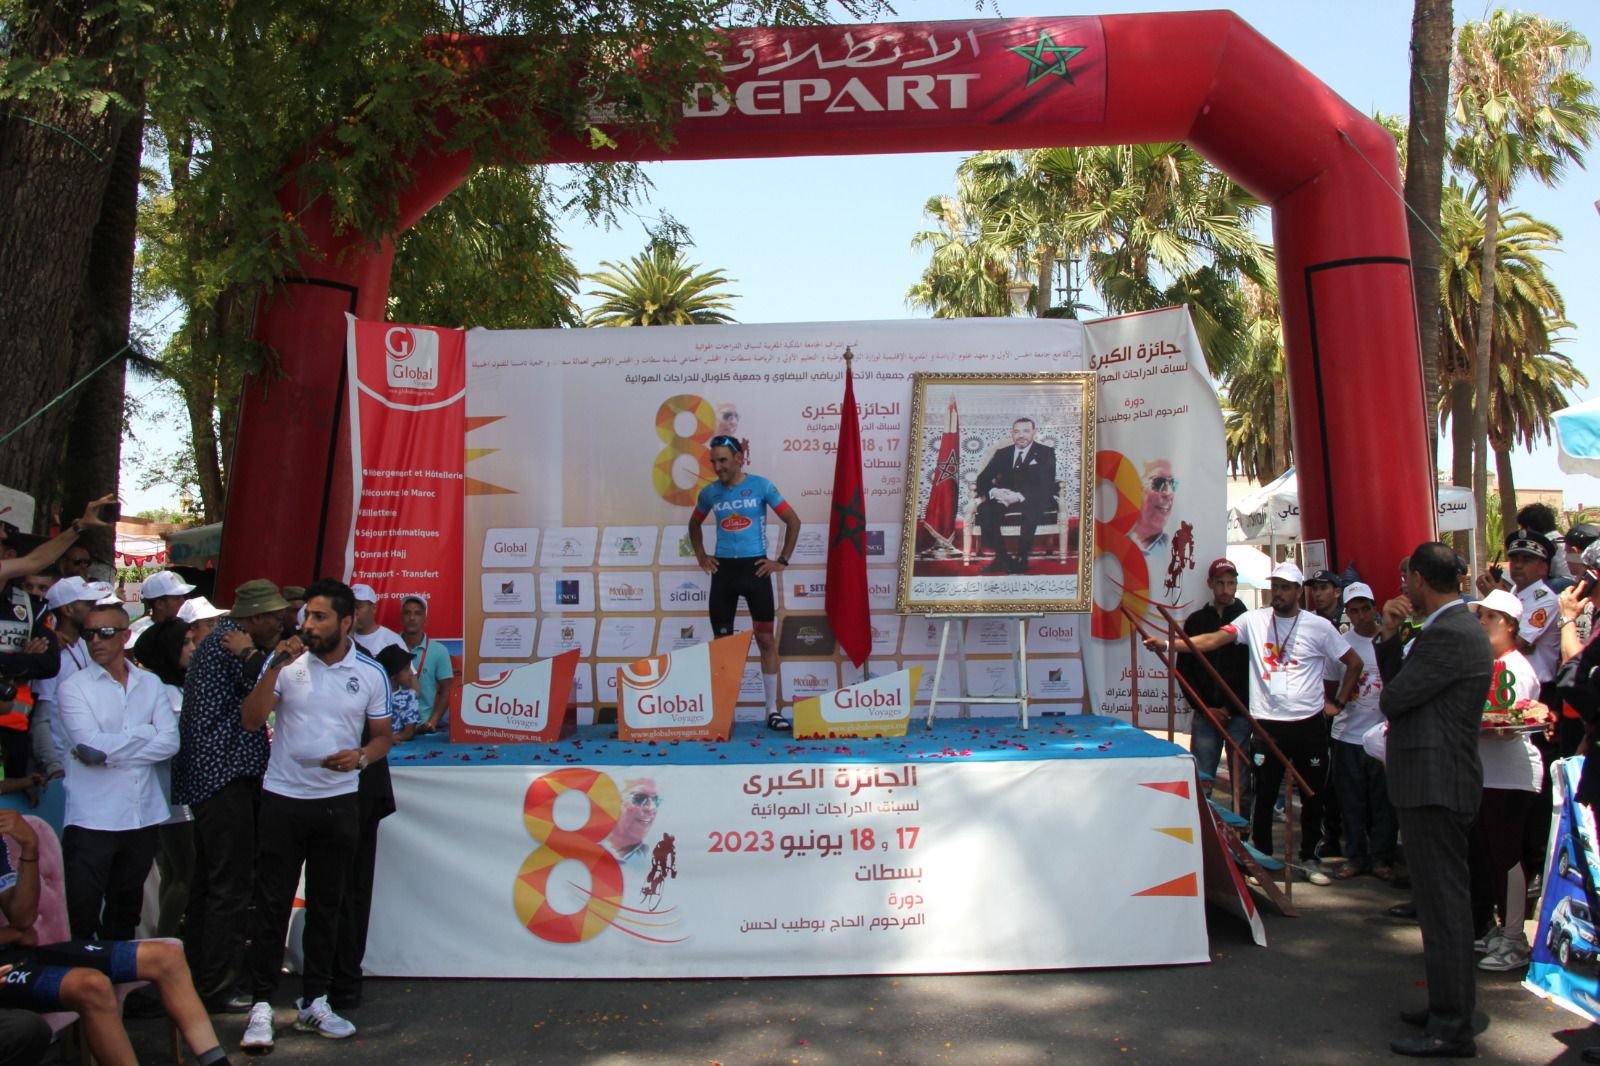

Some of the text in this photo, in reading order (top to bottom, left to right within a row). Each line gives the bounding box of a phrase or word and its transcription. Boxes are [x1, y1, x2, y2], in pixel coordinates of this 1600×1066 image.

[1089, 345, 1132, 370] الكبرى
[393, 364, 433, 380] Global
[1122, 366, 1158, 380] الدراجات
[1160, 361, 1188, 376] لسباق
[625, 373, 661, 384] الهوائية
[663, 372, 699, 384] للدراجات
[732, 372, 762, 382] جمعية
[1124, 397, 1145, 409] دورة
[1132, 409, 1153, 422] الحاج
[1154, 405, 1188, 419] المرحوم
[783, 439, 820, 452] 2023
[887, 439, 900, 451] 17
[425, 470, 464, 480] Hôtellerie
[410, 489, 436, 497] Maroc
[713, 498, 757, 511] KACM
[1438, 502, 1467, 517] سيدي
[1278, 504, 1299, 521] علي
[360, 527, 440, 539] Séjour thématiques
[390, 549, 407, 559] Hajj
[494, 541, 527, 553] Global
[401, 570, 439, 578] Transfert
[1038, 625, 1073, 638] Global
[475, 693, 541, 718] Global
[637, 694, 705, 716] Global
[834, 688, 901, 709] Global
[671, 713, 705, 724] Voyages
[868, 708, 901, 719] Voyages
[506, 716, 538, 728] Voyages
[743, 765, 917, 798] الجائزة الكبرى
[751, 800, 920, 819] لسباق الدراجات الهوائية
[708, 830, 775, 853] 2023
[780, 829, 843, 858] يونيو
[850, 828, 875, 851] 18
[896, 827, 921, 849] 17
[855, 863, 923, 883] بسطات
[888, 893, 924, 909] دورة
[740, 913, 925, 933] المرحوم الحاج بوطيب لحسن
